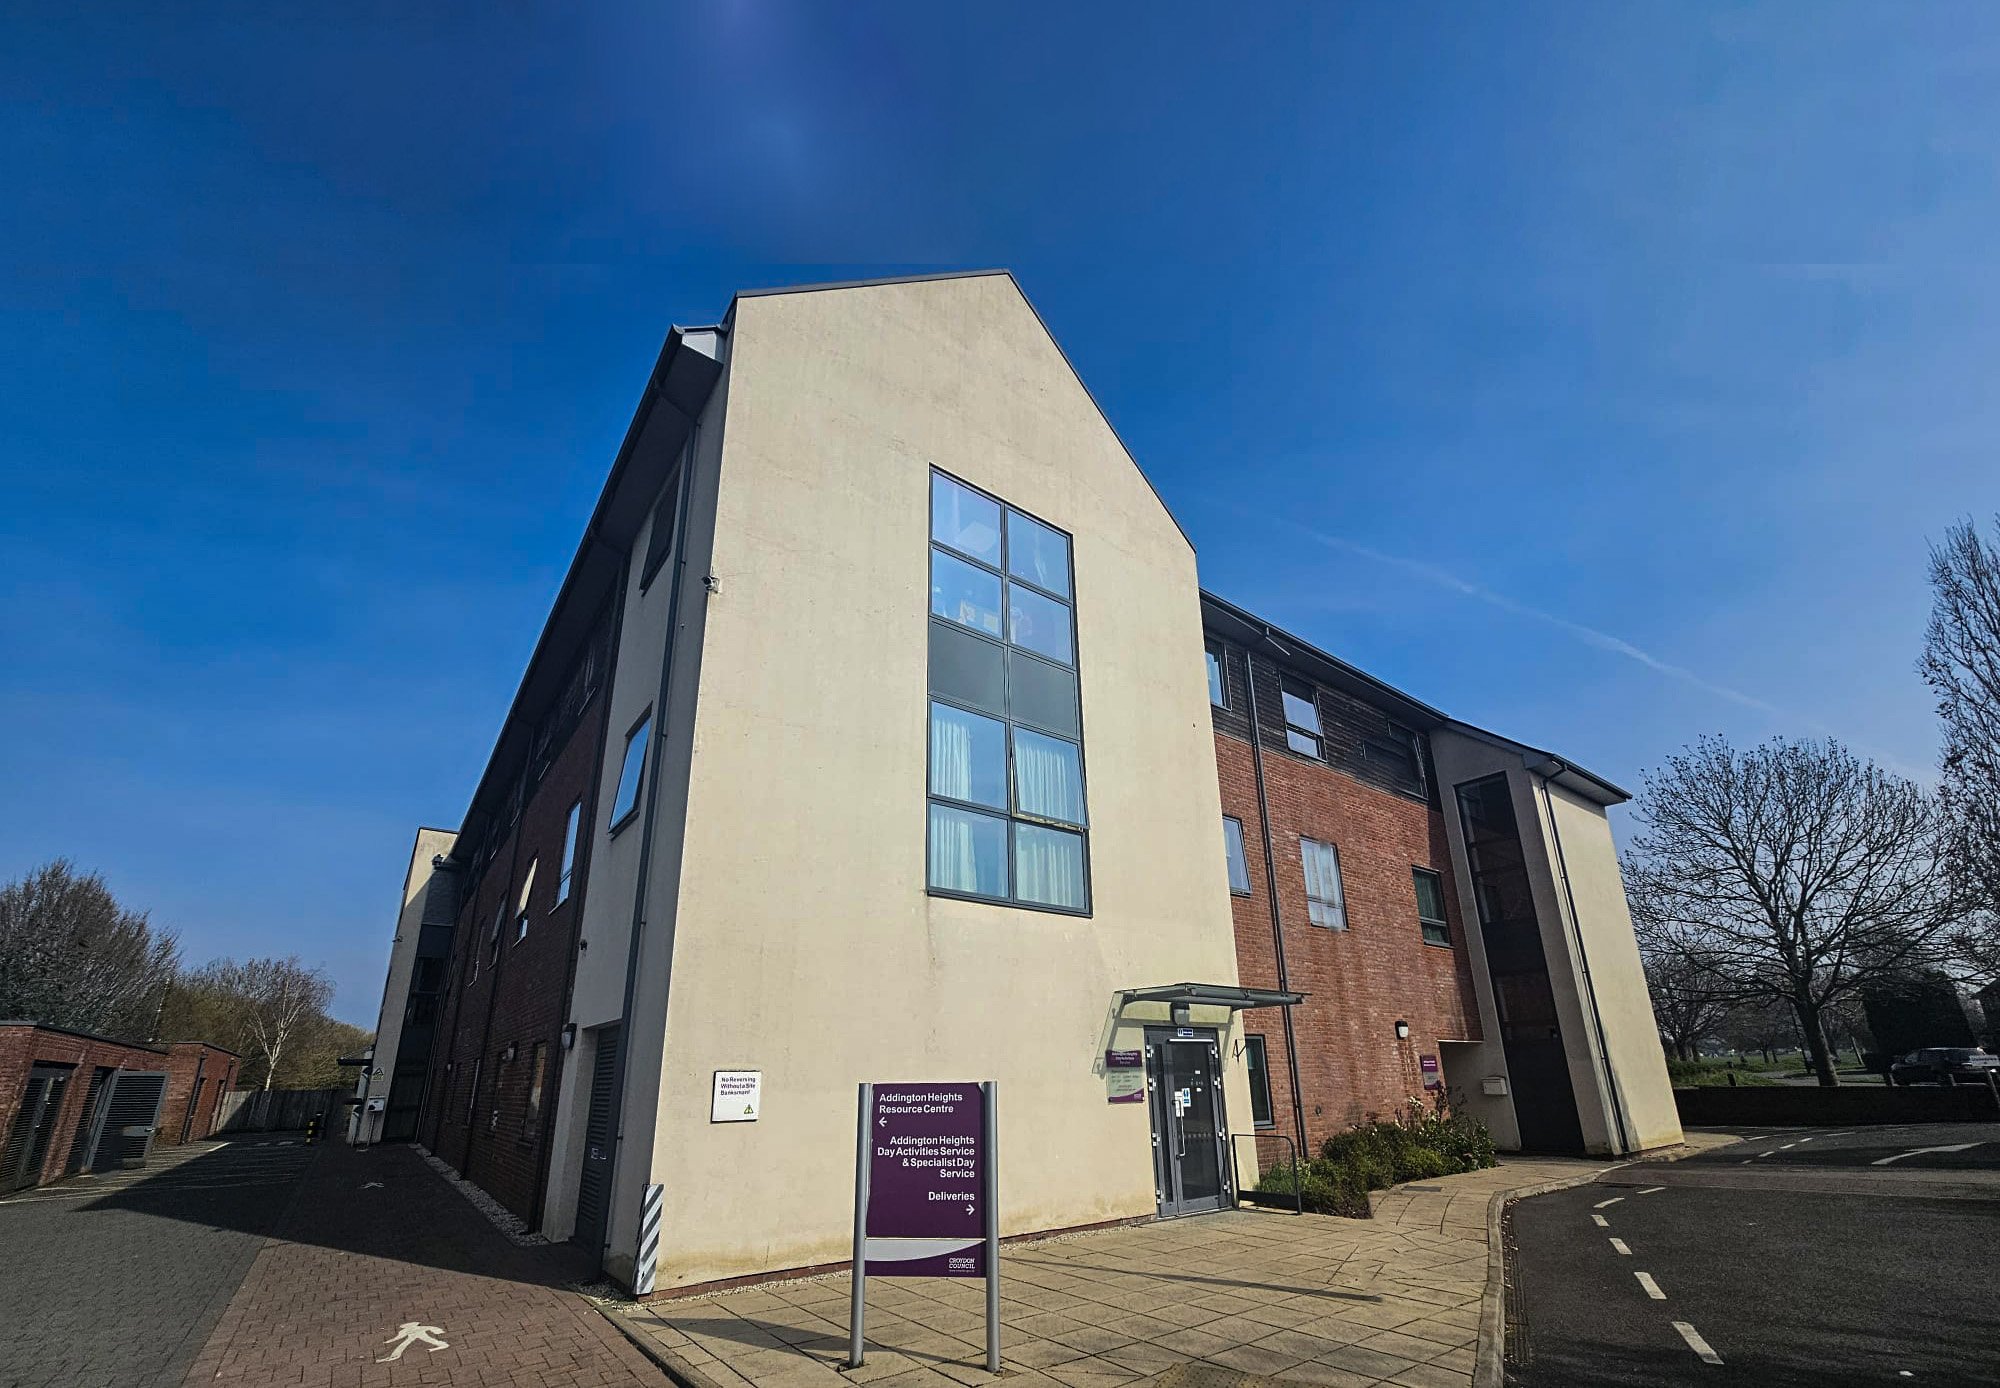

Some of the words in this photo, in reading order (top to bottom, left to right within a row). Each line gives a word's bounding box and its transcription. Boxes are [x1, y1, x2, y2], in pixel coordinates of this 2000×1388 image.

[879, 1093, 927, 1103] Addington
[928, 1093, 963, 1103] Heights
[879, 1105, 923, 1114] Resource
[923, 1104, 954, 1113] Centre
[890, 1136, 938, 1146] Addington
[940, 1136, 975, 1146] Heights
[877, 1147, 895, 1158] Day
[896, 1147, 939, 1156] Activities
[940, 1147, 975, 1156] Service
[902, 1158, 909, 1167] &
[910, 1158, 956, 1168] Specialist
[957, 1158, 975, 1168] Day
[940, 1169, 975, 1178] Service
[928, 1192, 975, 1201] Deliveries
